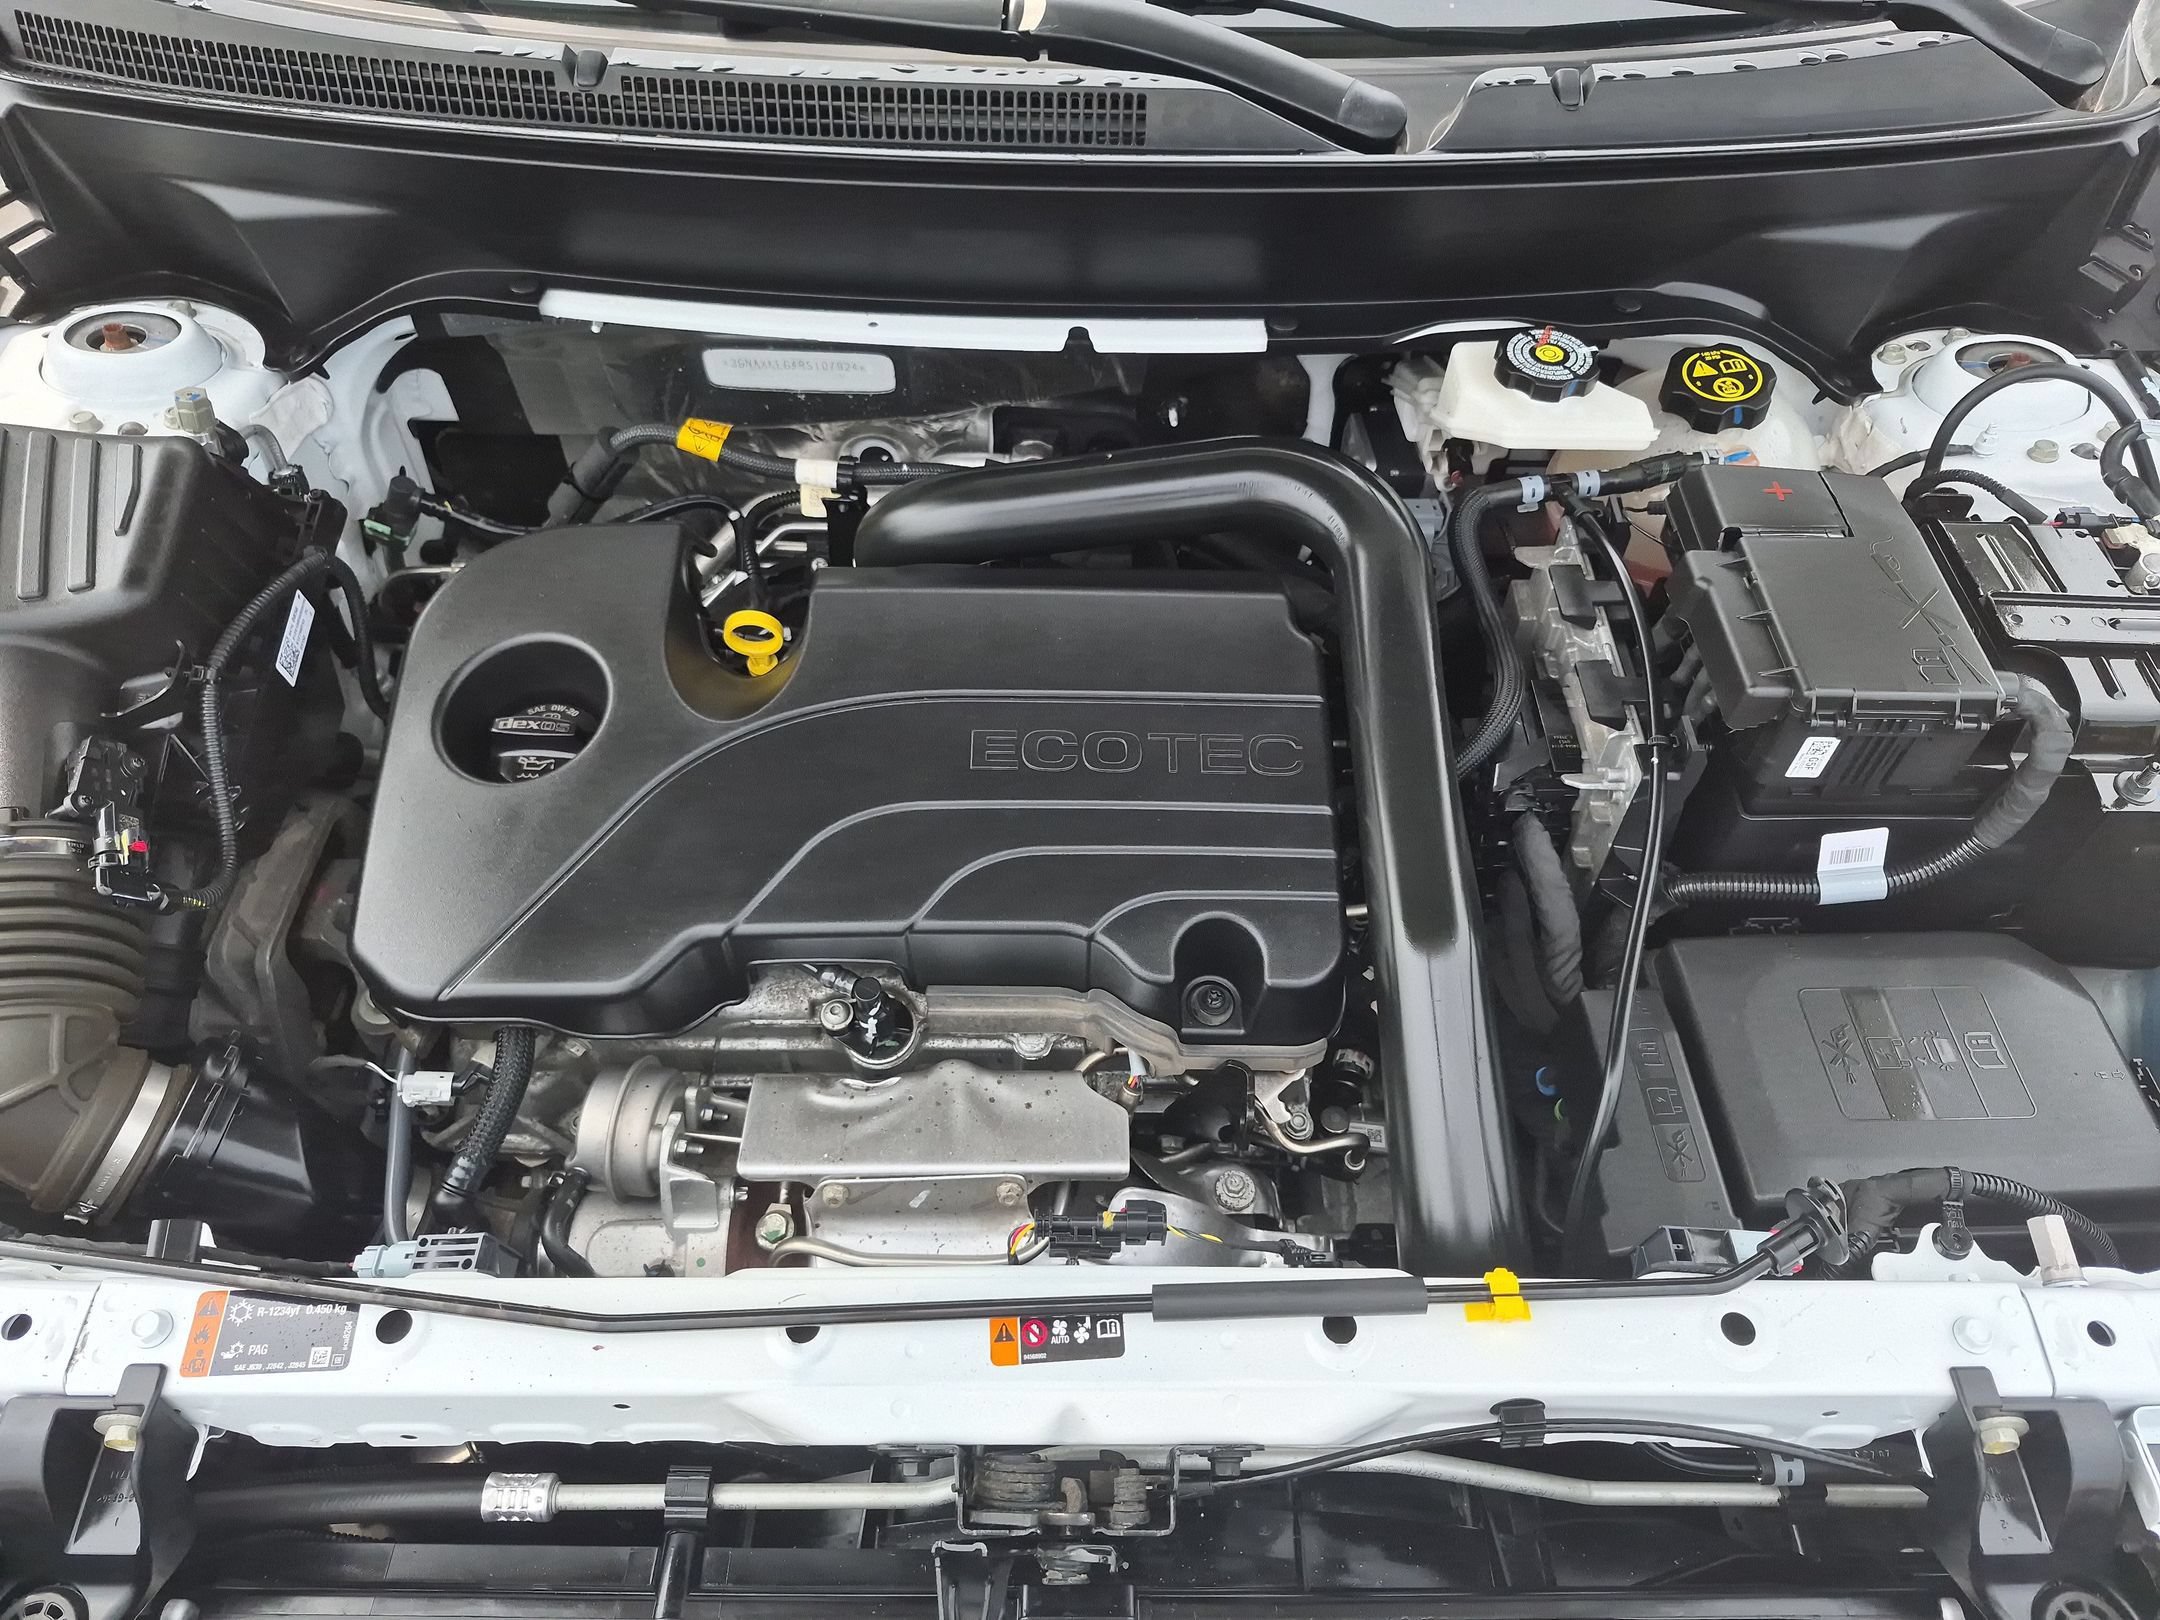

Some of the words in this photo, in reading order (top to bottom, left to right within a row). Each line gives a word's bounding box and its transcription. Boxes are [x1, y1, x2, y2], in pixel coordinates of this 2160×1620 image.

[527, 705, 546, 715] SAE
[550, 704, 580, 717] 0W-20
[969, 729, 1304, 777] ECOTEC
[256, 1305, 301, 1318] R-1234yf
[305, 1303, 333, 1315] 0.450
[334, 1303, 348, 1316] kg
[1051, 1334, 1070, 1345] AUTO
[247, 1343, 269, 1356] PAG
[233, 1363, 247, 1371] SAE
